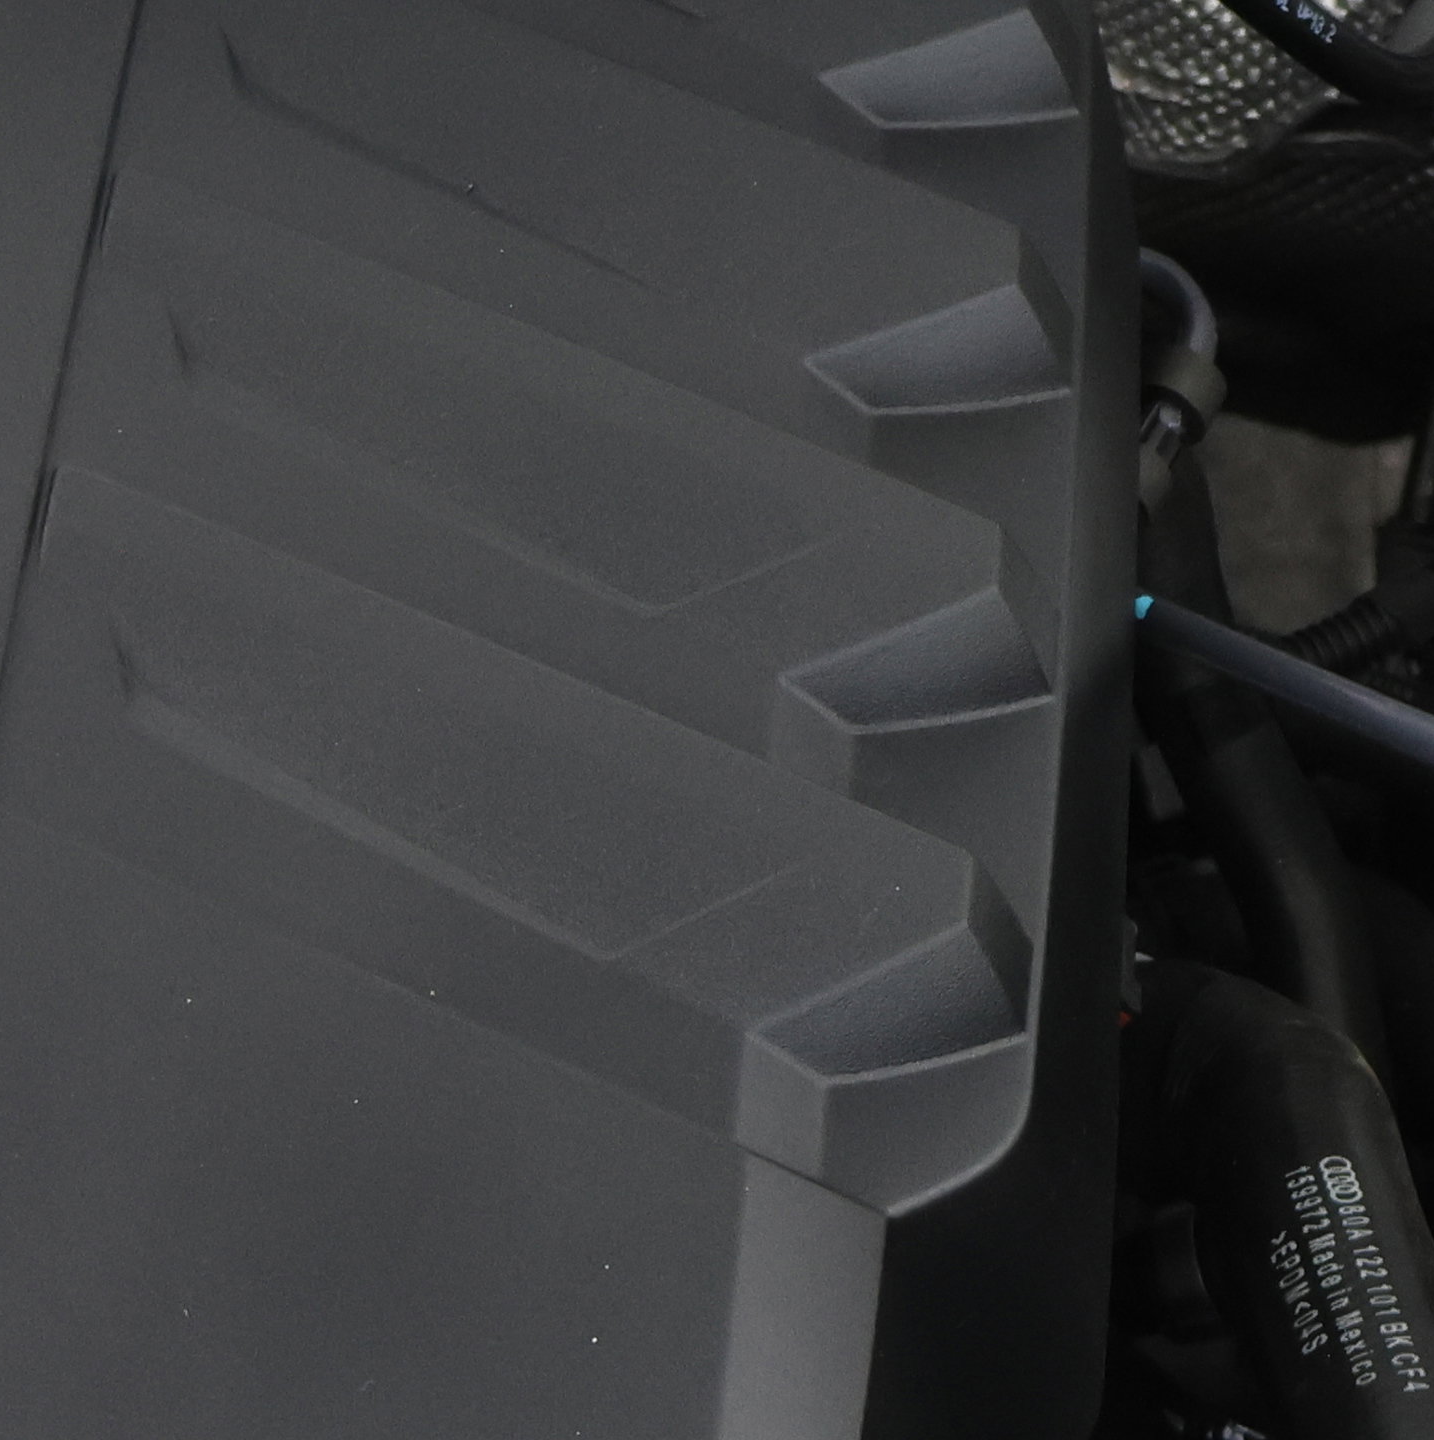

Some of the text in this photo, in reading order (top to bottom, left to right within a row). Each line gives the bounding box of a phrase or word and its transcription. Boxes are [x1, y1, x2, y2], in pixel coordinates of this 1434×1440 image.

[1338, 1204, 1374, 1242] 80A
[1307, 1232, 1343, 1288] Made
[1352, 1244, 1389, 1280] 122
[1325, 1287, 1354, 1312] in
[1365, 1283, 1402, 1318] 101
[1334, 1310, 1377, 1388] Mexico
